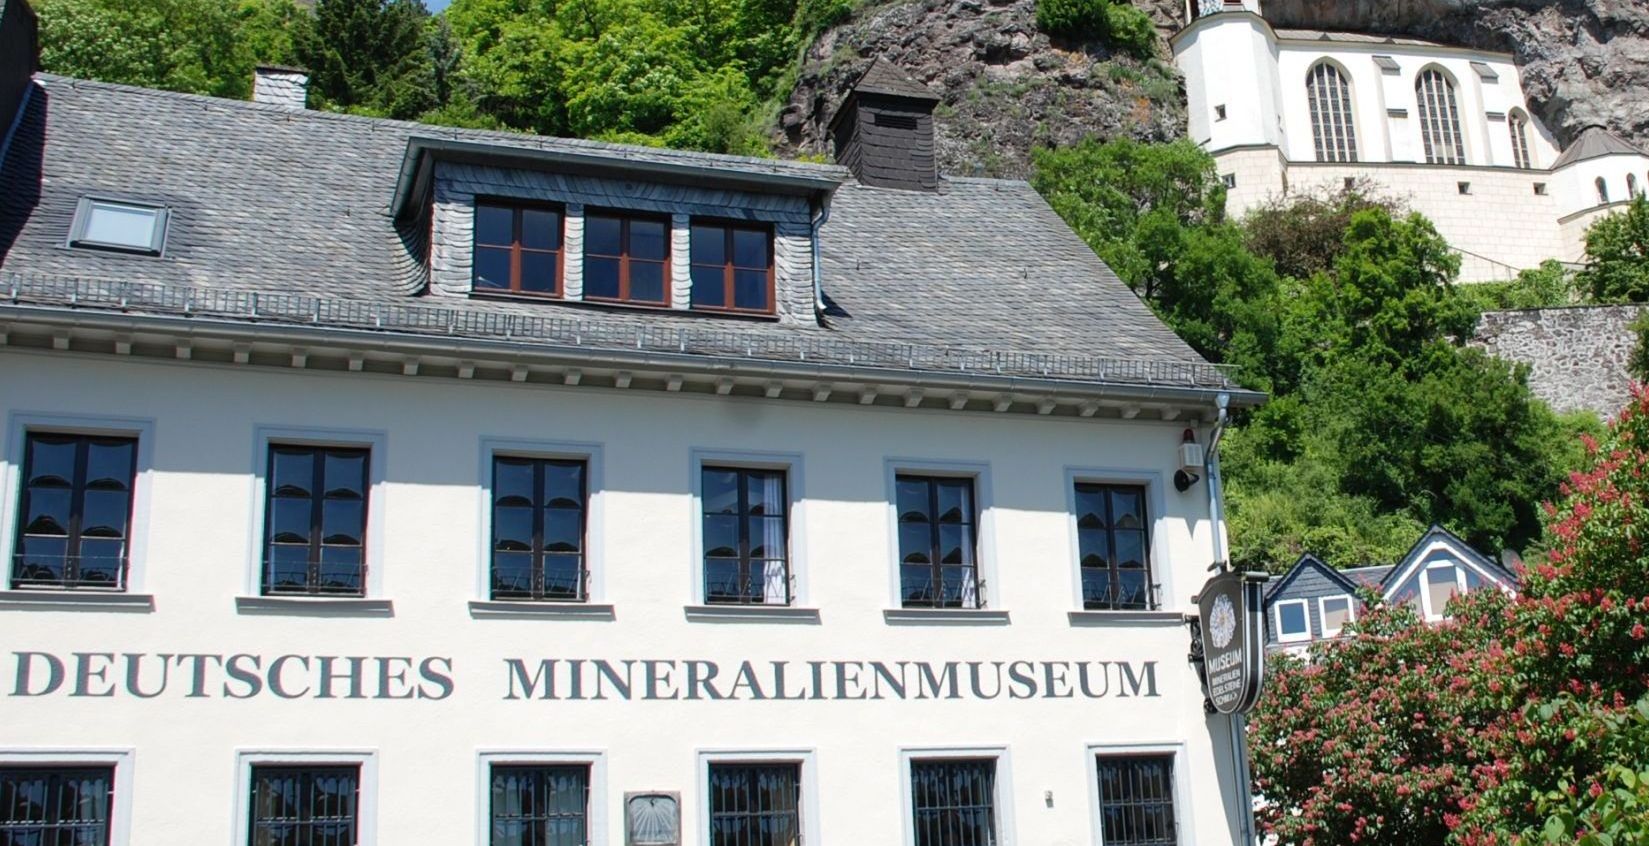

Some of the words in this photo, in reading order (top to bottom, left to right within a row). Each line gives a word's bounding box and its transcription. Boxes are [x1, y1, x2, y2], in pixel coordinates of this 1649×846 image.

[1208, 647, 1242, 675] MUSEUM
[8, 651, 454, 700] DEUTSCHES
[503, 658, 1160, 699] MINERALIENMUSEUM
[1212, 678, 1241, 697] EDELSTEINE
